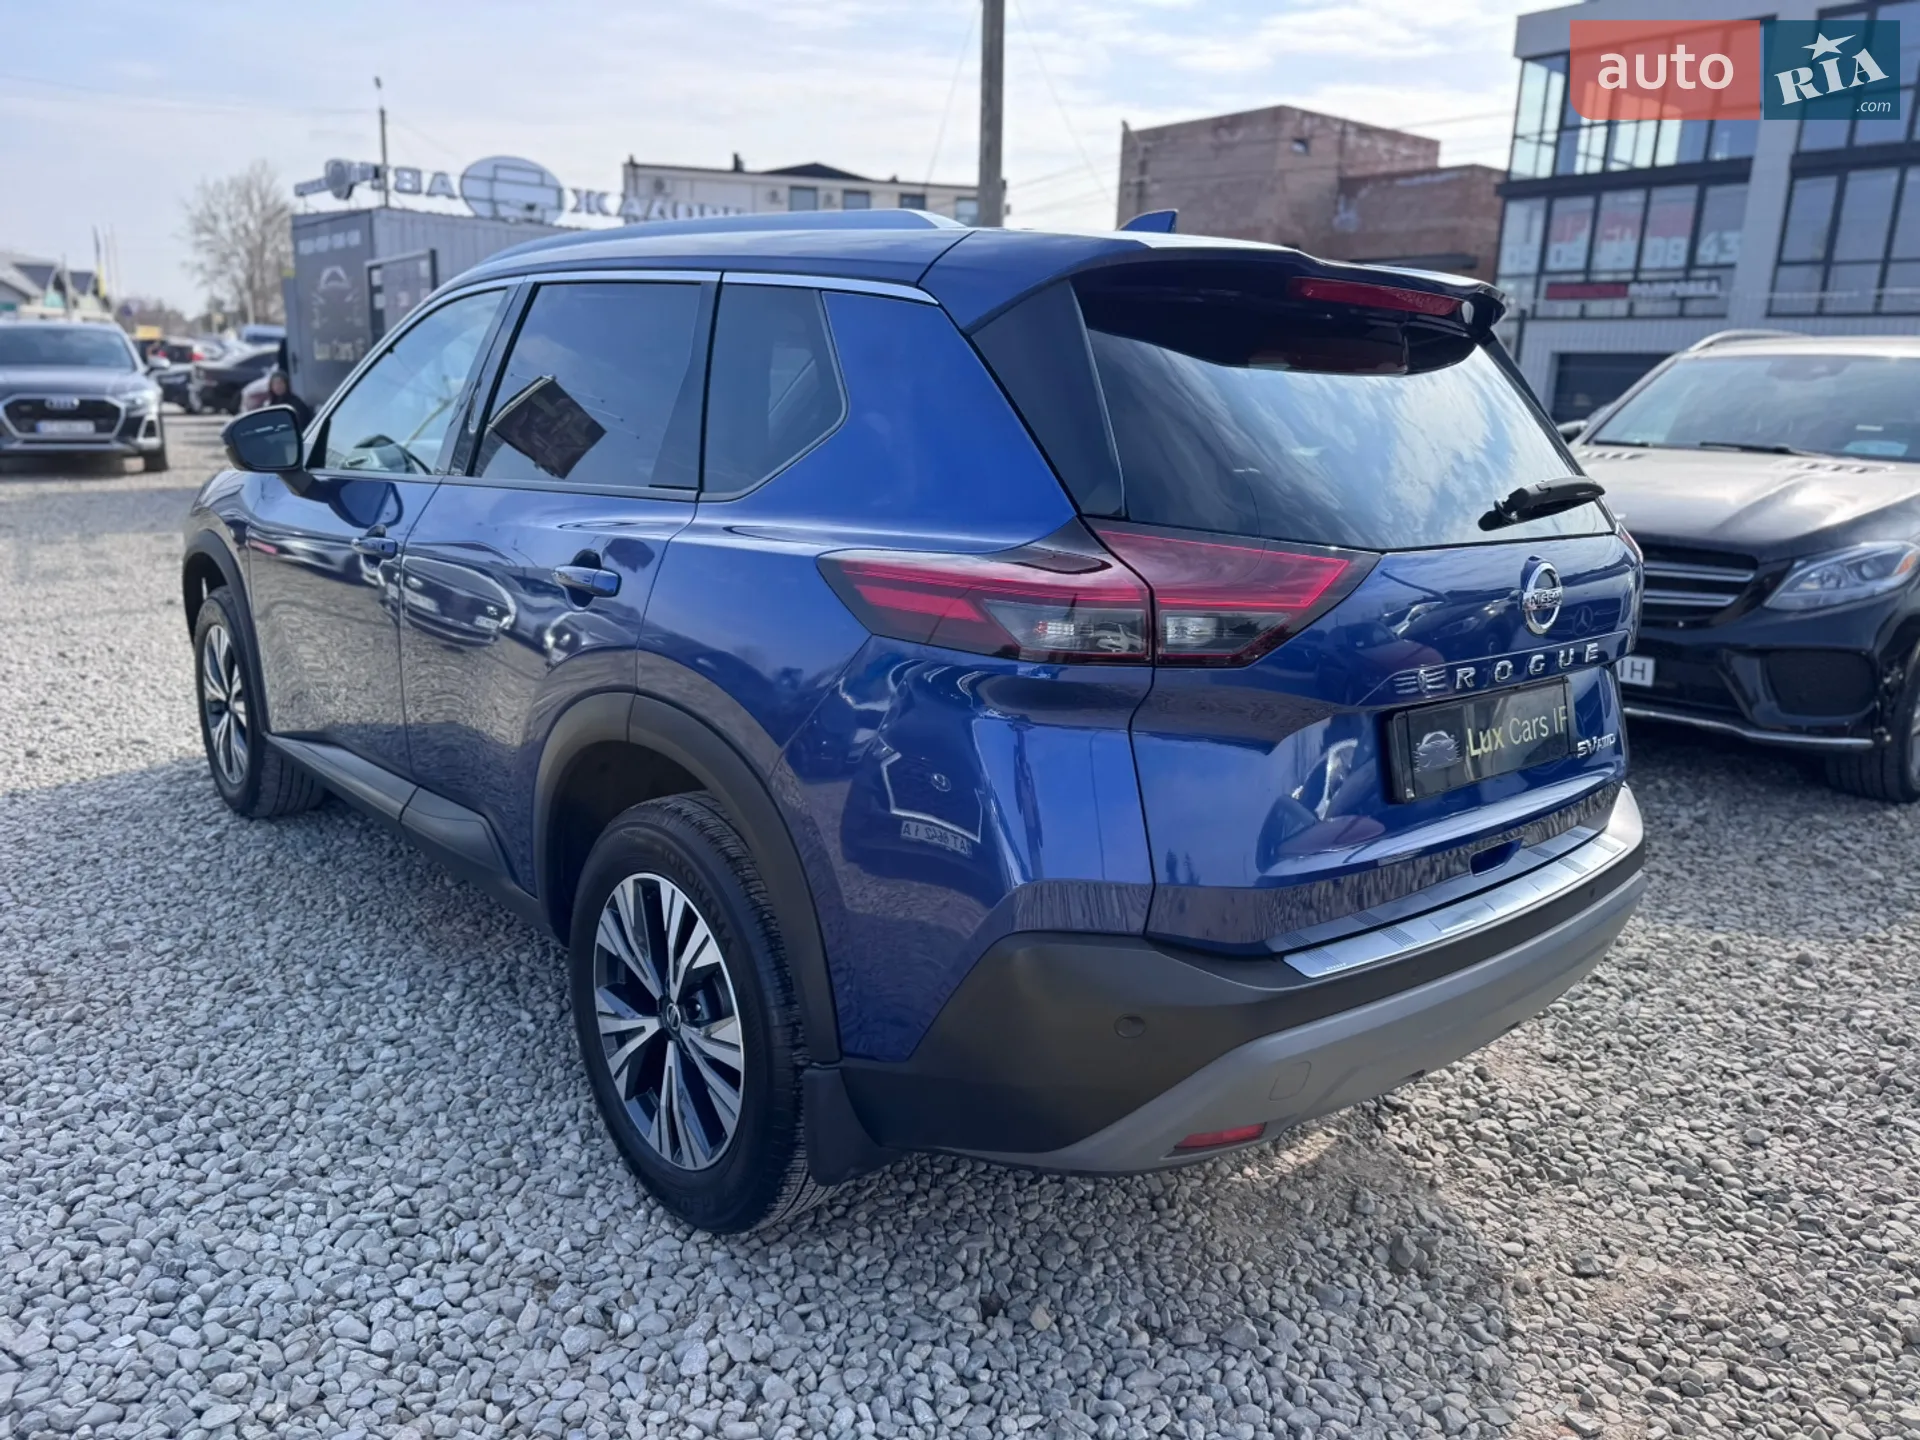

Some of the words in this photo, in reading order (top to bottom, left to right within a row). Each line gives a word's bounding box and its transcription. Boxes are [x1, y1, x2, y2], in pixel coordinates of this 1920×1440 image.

[1455, 642, 1599, 690] ROGUE
[1467, 726, 1505, 758] Lux
[1508, 713, 1549, 745] Cars
[1553, 705, 1568, 735] IF
[1577, 735, 1598, 759] SV
[662, 849, 733, 955] YOKOHAMA
